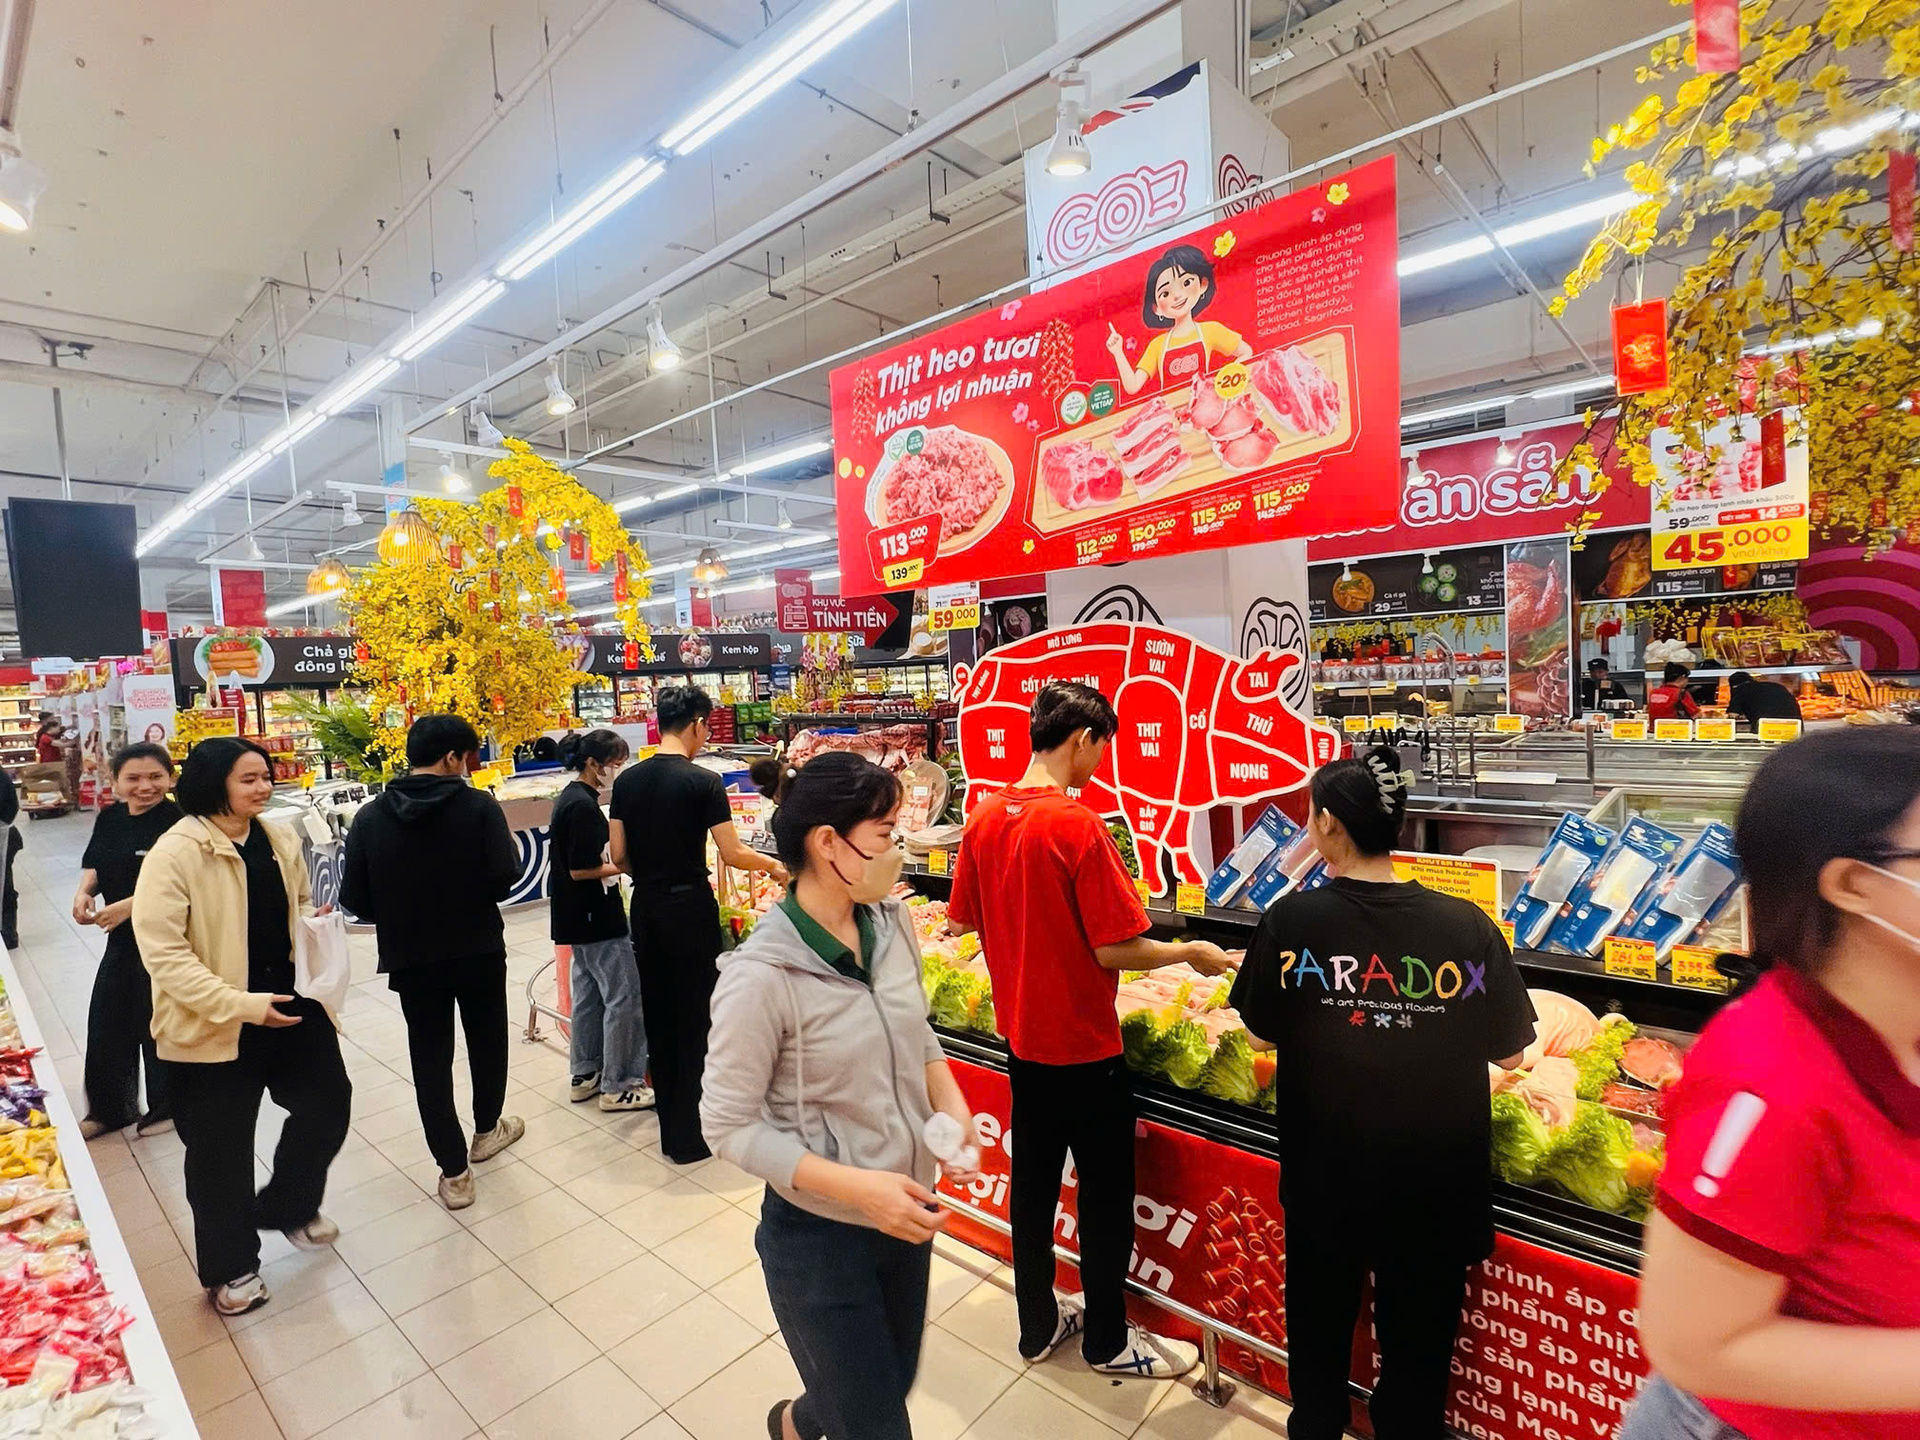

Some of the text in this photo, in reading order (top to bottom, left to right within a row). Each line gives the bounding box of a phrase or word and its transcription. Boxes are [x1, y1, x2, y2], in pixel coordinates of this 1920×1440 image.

[878, 332, 1042, 398] Thịt heo tươi
[875, 368, 1033, 437] không lợi nhuận
[1664, 526, 1791, 563] 45.000
[813, 606, 888, 628] TÍNH TIỀN
[934, 607, 976, 629] 59.000
[303, 644, 334, 657] Chả
[722, 645, 759, 656] Kem hộp
[1145, 639, 1175, 657] SƯỜN
[295, 659, 336, 673] đông
[1149, 658, 1166, 674] VAI
[1248, 671, 1269, 688] TAI
[1189, 709, 1206, 729] CỔ
[1247, 712, 1274, 736] THỦ
[986, 729, 1005, 743] THỊT
[1136, 723, 1162, 741] THỊT
[1140, 742, 1160, 757] VAI
[1230, 763, 1269, 782] NỌNG
[1279, 947, 1487, 1000] PARADOX
[1321, 998, 1335, 1006] we
[1337, 999, 1354, 1007] are
[1482, 1259, 1607, 1316] trình áp
[1482, 1288, 1568, 1334] phẩm
[1579, 1321, 1639, 1359] thịt
[1461, 1308, 1528, 1348] ông
[1538, 1336, 1578, 1365] áp
[1483, 1344, 1534, 1379] sản
[1450, 1356, 1502, 1394] ông
[1512, 1381, 1579, 1426] lạnh
[1456, 1388, 1506, 1422] của
